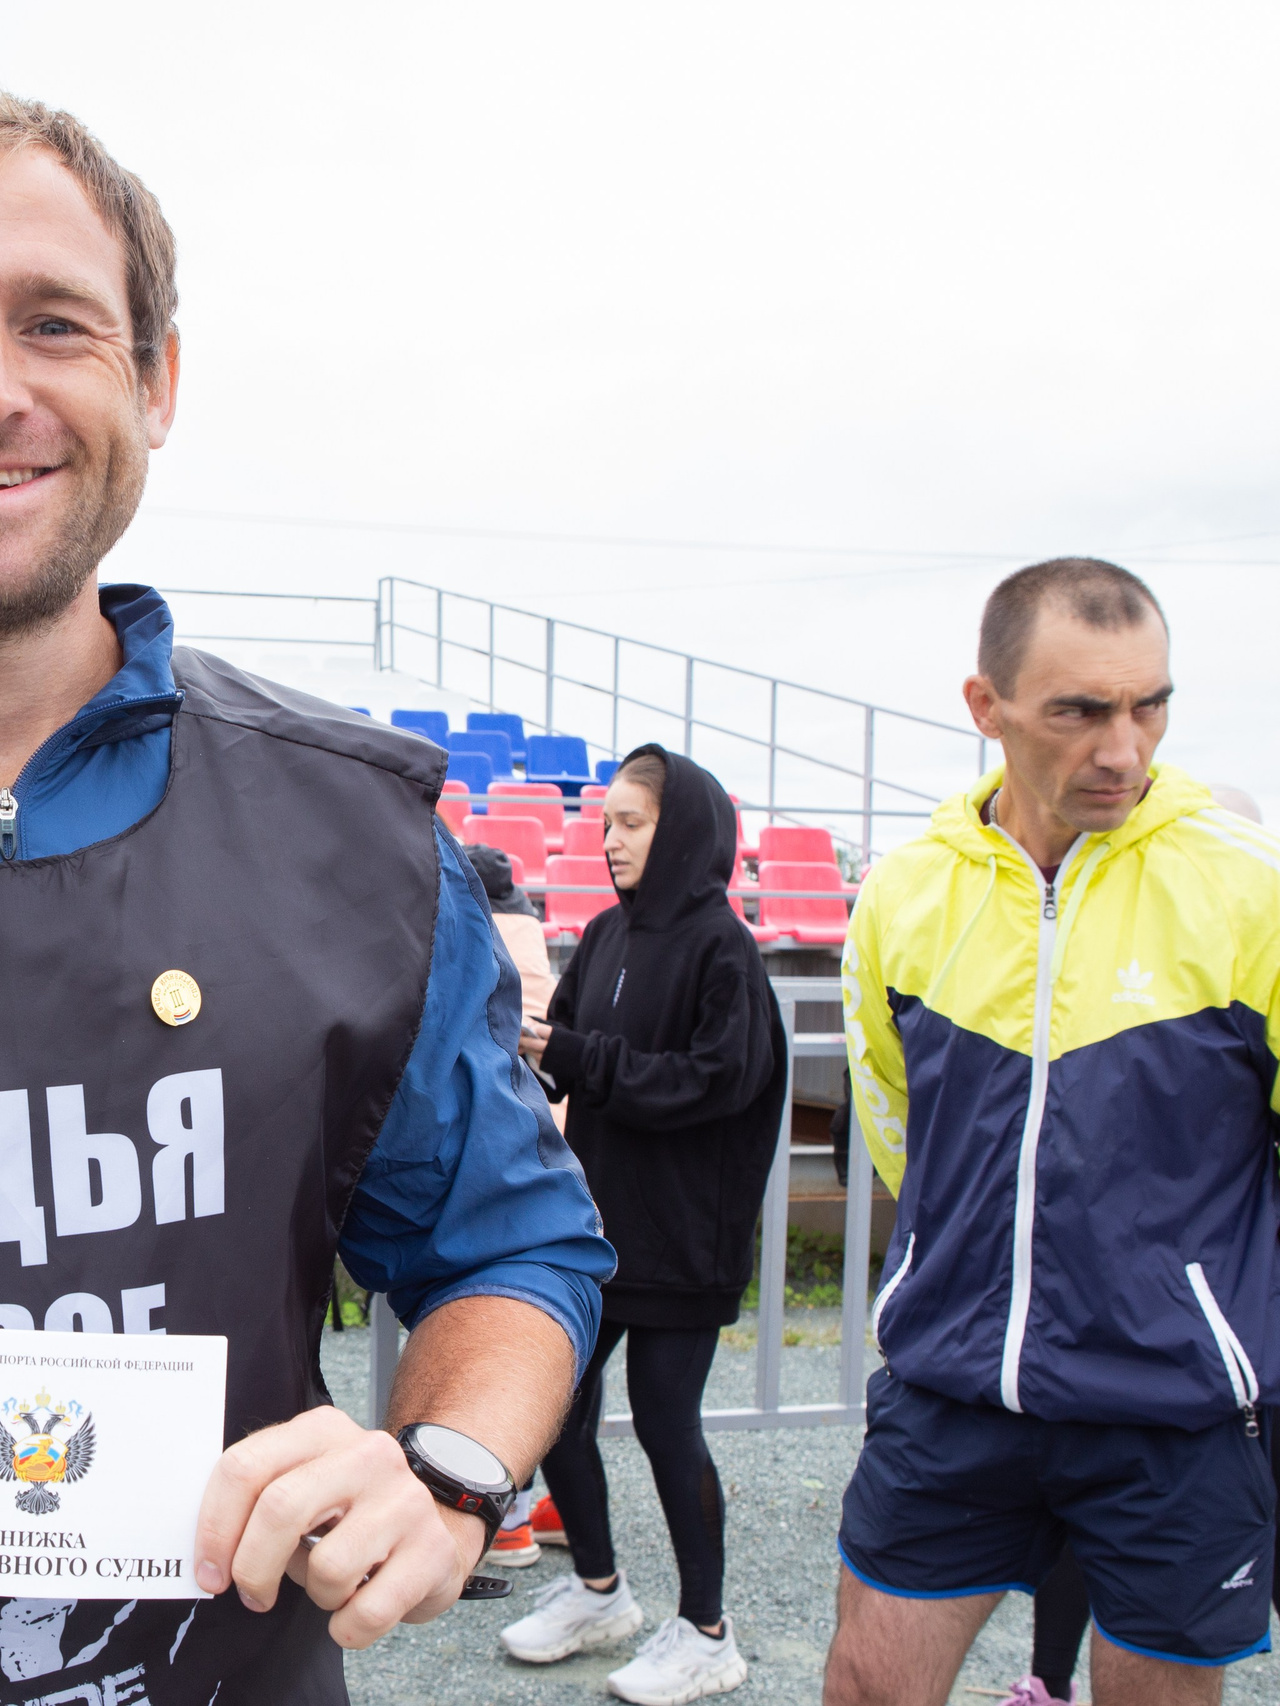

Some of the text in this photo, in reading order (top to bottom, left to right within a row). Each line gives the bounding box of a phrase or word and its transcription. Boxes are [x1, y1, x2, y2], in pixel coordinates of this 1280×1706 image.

[39, 1356, 121, 1370] РОССИЙСКОЙ
[124, 1360, 194, 1373] ФЕДЕРАЦИИ
[95, 1557, 183, 1582] СУДЬИ
